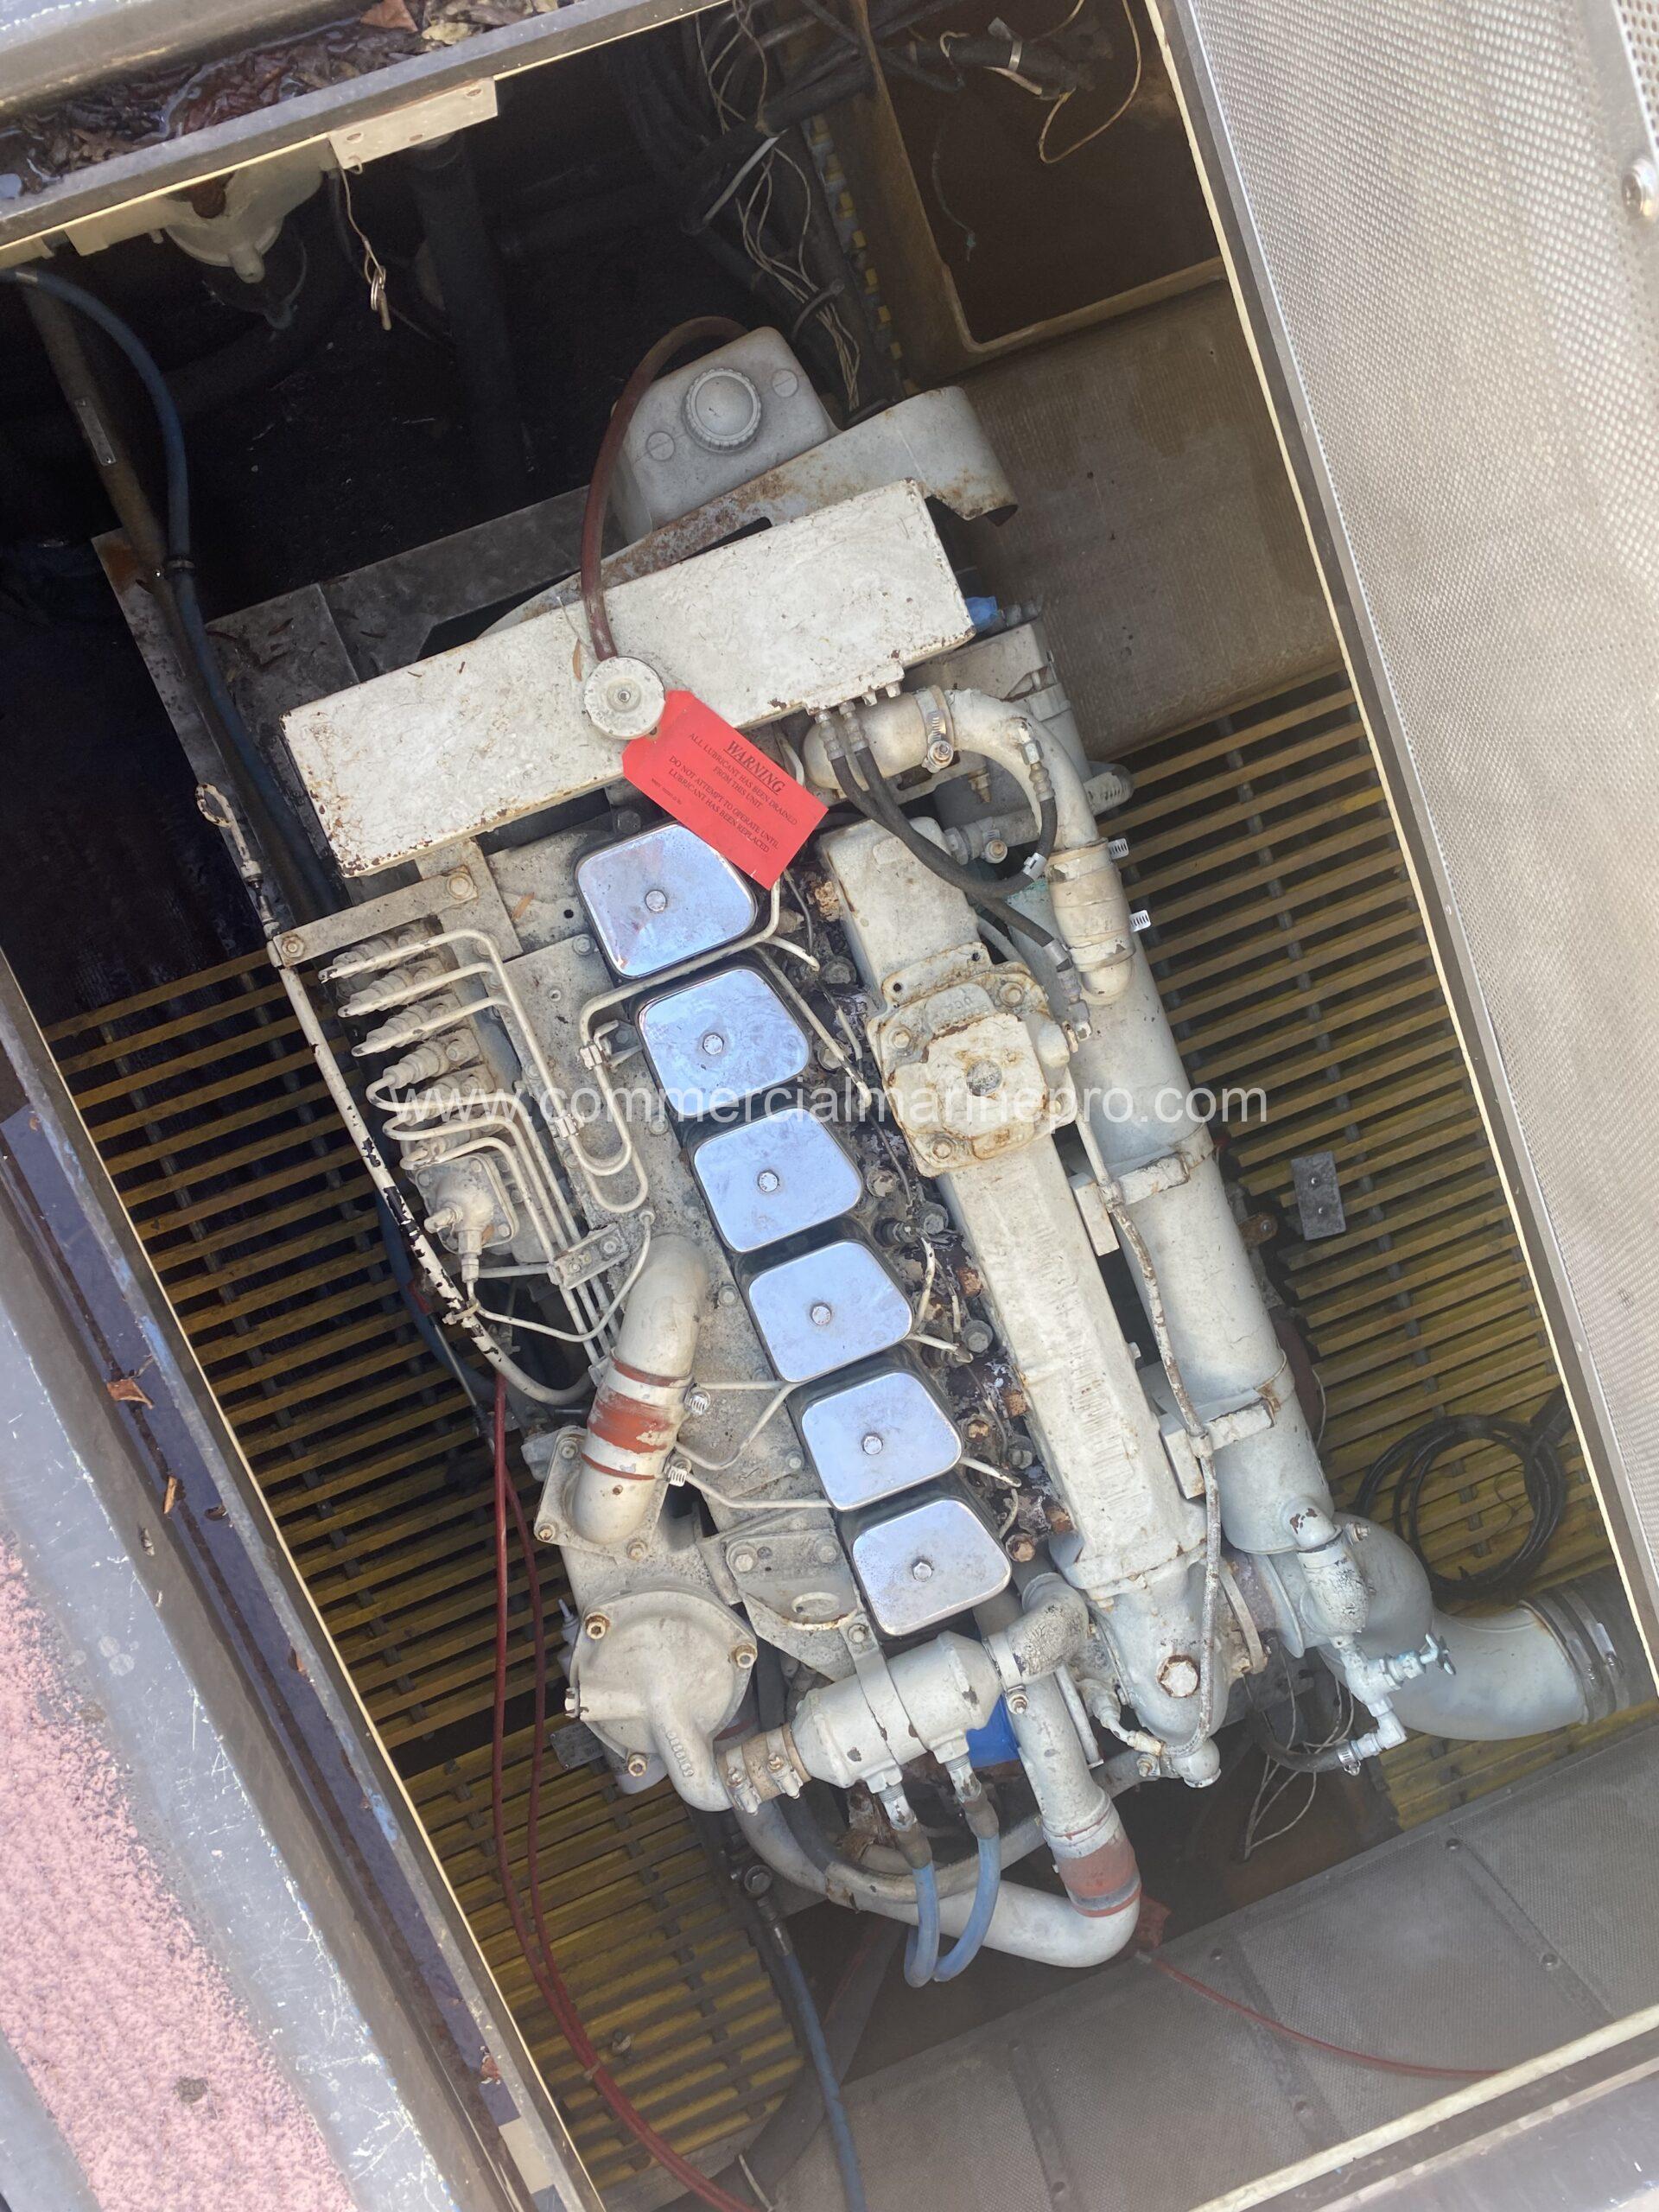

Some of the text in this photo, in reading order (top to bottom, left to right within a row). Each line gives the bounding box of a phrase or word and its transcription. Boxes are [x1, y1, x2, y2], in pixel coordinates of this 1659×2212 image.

[669, 755, 683, 768] DO
[681, 766, 696, 779] NOT
[695, 777, 725, 804] ATTEMPT
[723, 800, 734, 811] TO
[731, 807, 762, 834] OPERATE
[760, 830, 781, 849] UNTIL
[688, 732, 798, 825] ALL LUBRICANT HAS BEEN DRAINED
[712, 765, 733, 785] FROM
[730, 780, 747, 796] THIS
[726, 740, 785, 793] WARNING
[669, 768, 706, 801] LUBRICANT
[705, 798, 721, 812] HAS
[719, 810, 738, 827] BEEN
[735, 823, 770, 853] REPLACED
